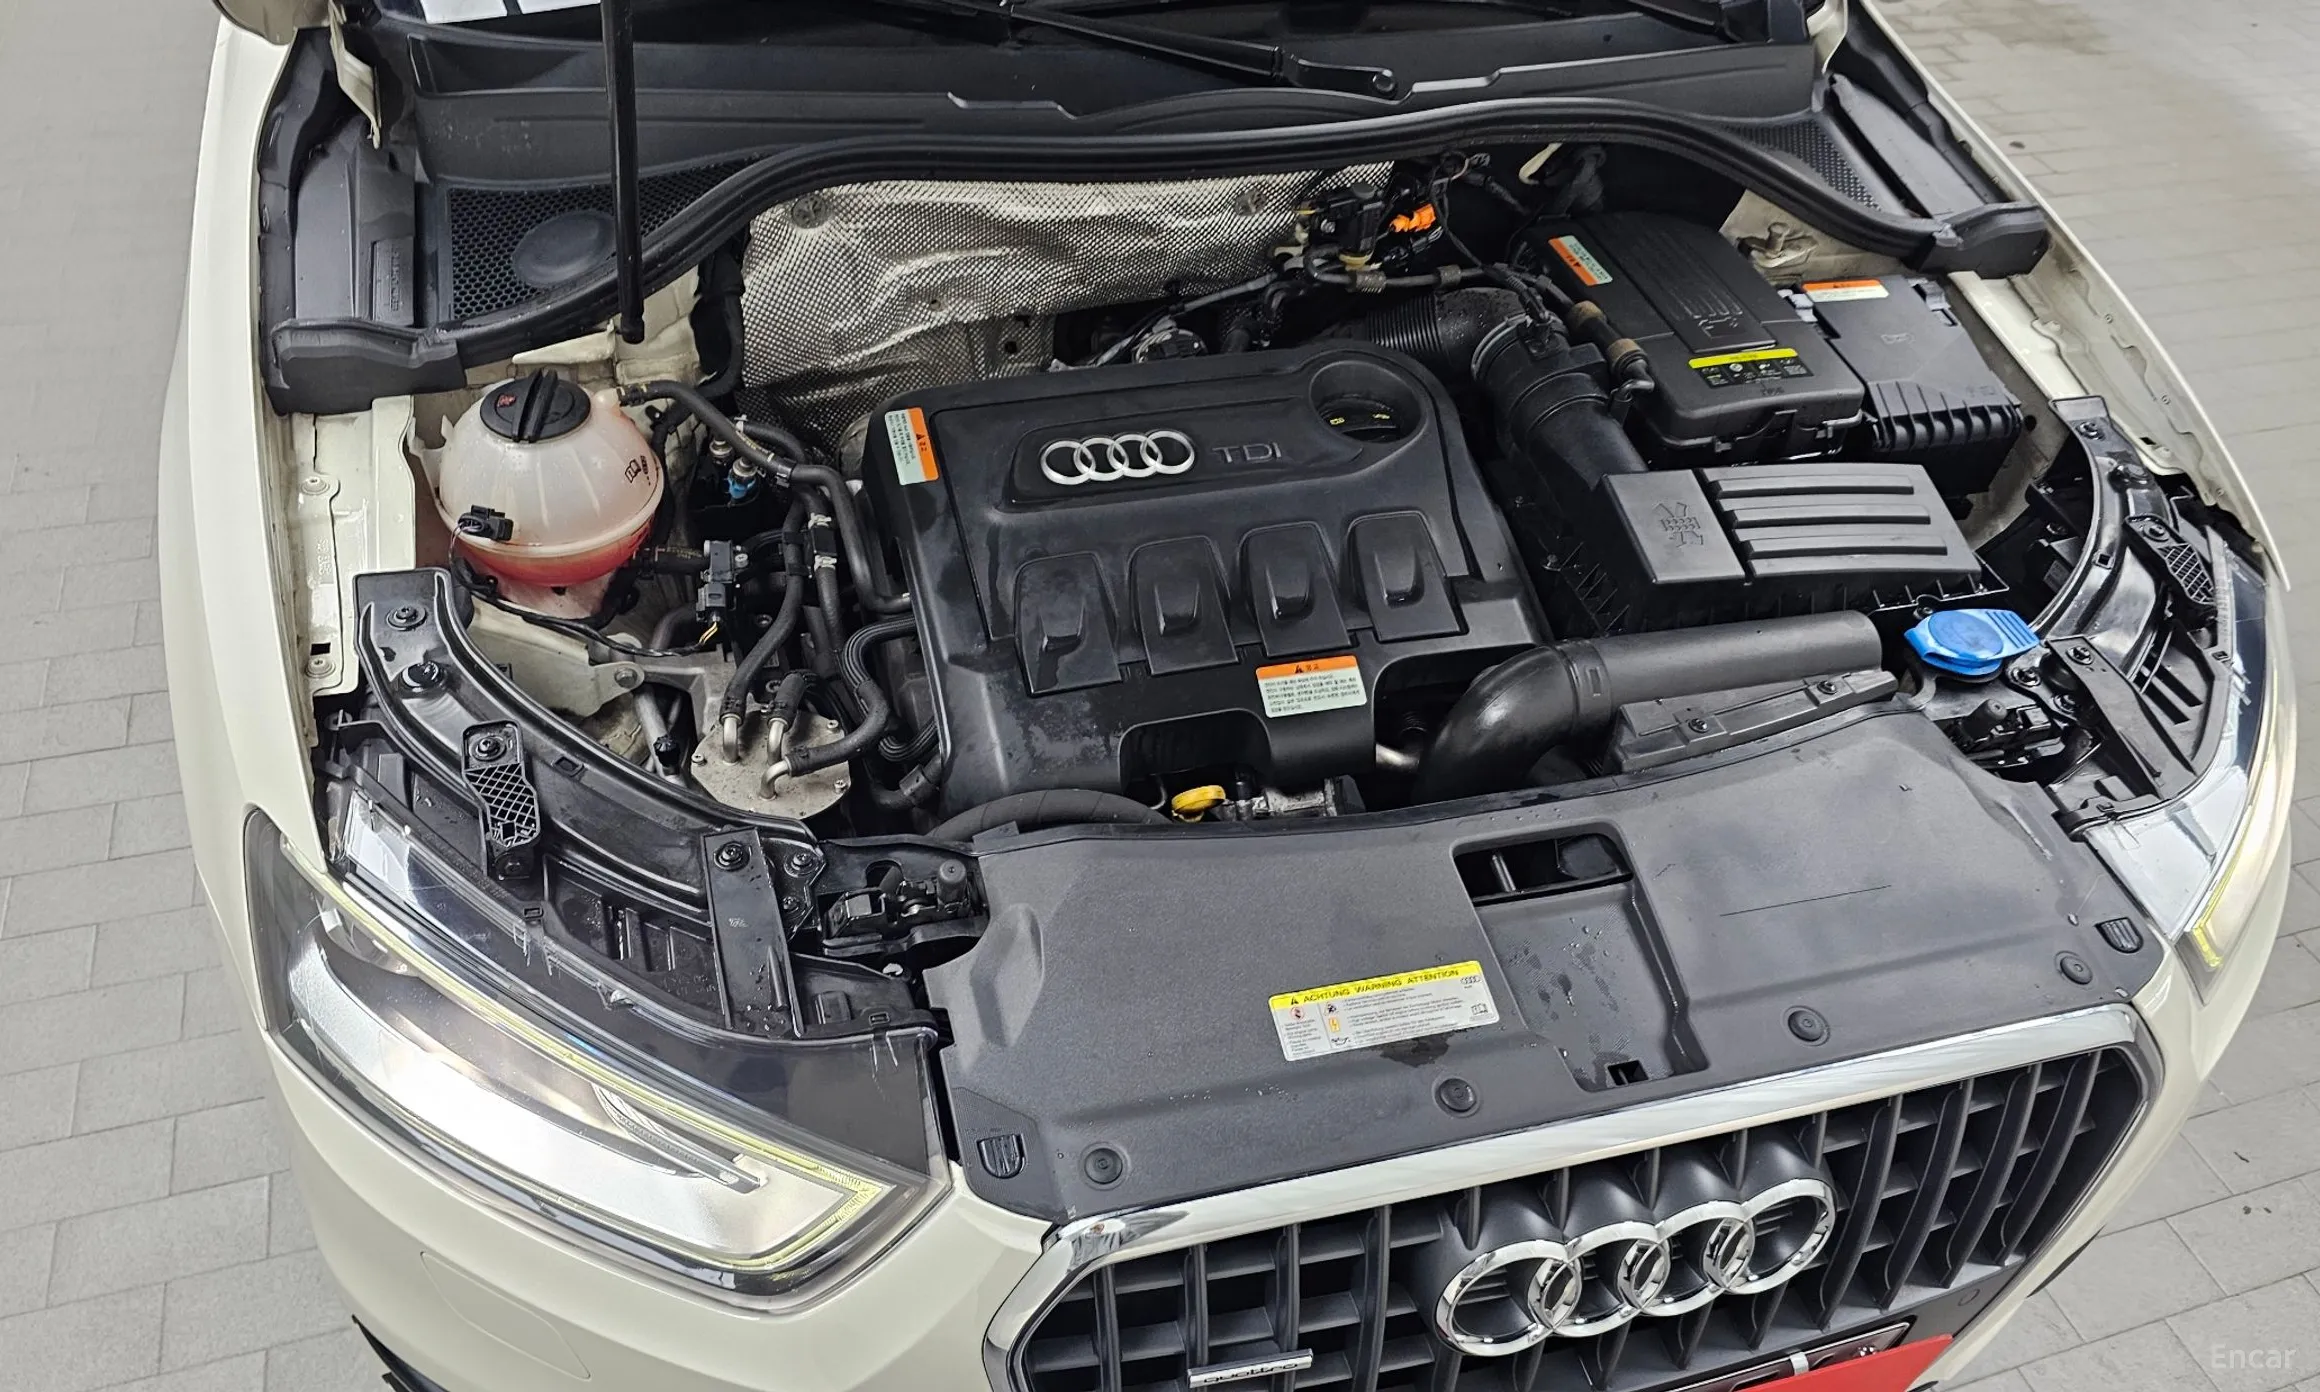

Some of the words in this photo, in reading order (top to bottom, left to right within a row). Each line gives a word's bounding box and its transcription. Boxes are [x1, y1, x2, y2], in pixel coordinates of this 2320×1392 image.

[1213, 442, 1283, 463] TDI
[1303, 987, 1350, 1002] ACHTUNG
[1355, 979, 1402, 993] WARNING
[1407, 970, 1459, 984] ATTENTION
[1203, 1362, 1298, 1383] quattro
